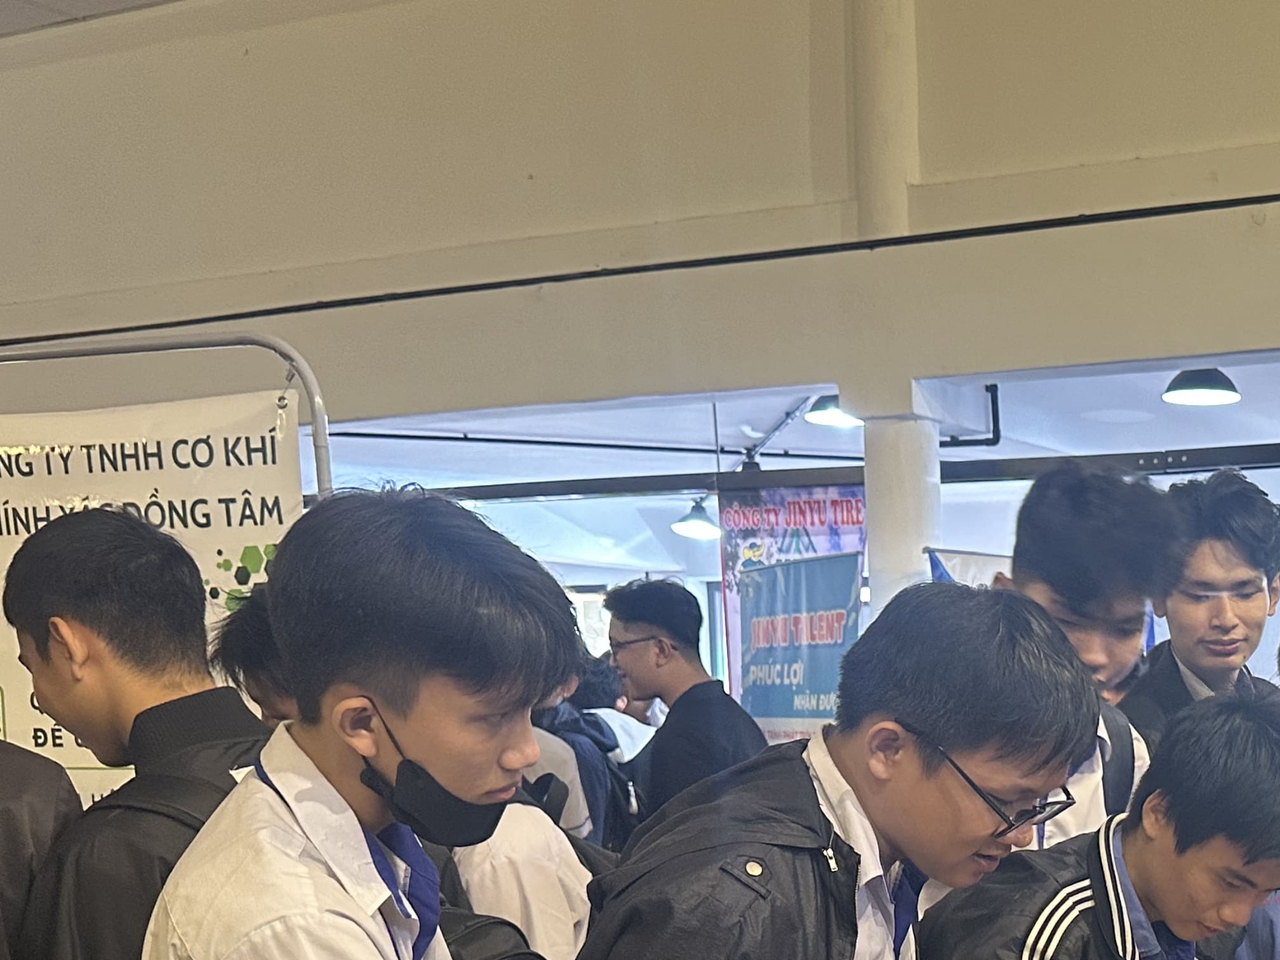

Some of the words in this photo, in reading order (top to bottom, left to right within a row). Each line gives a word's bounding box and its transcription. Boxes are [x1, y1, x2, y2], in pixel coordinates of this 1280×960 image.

[0, 452, 34, 478] NG
[40, 445, 74, 475] TY
[80, 439, 164, 474] TNHH
[170, 434, 214, 469] CƠ
[223, 426, 278, 465] KHÍ
[0, 499, 51, 536] ÍNH
[218, 490, 283, 528] TÂM
[723, 502, 761, 529] CÔNG
[764, 507, 781, 527] TY
[785, 499, 828, 527] JINYU
[830, 498, 864, 526] TIRE
[749, 658, 781, 685] PHÚC
